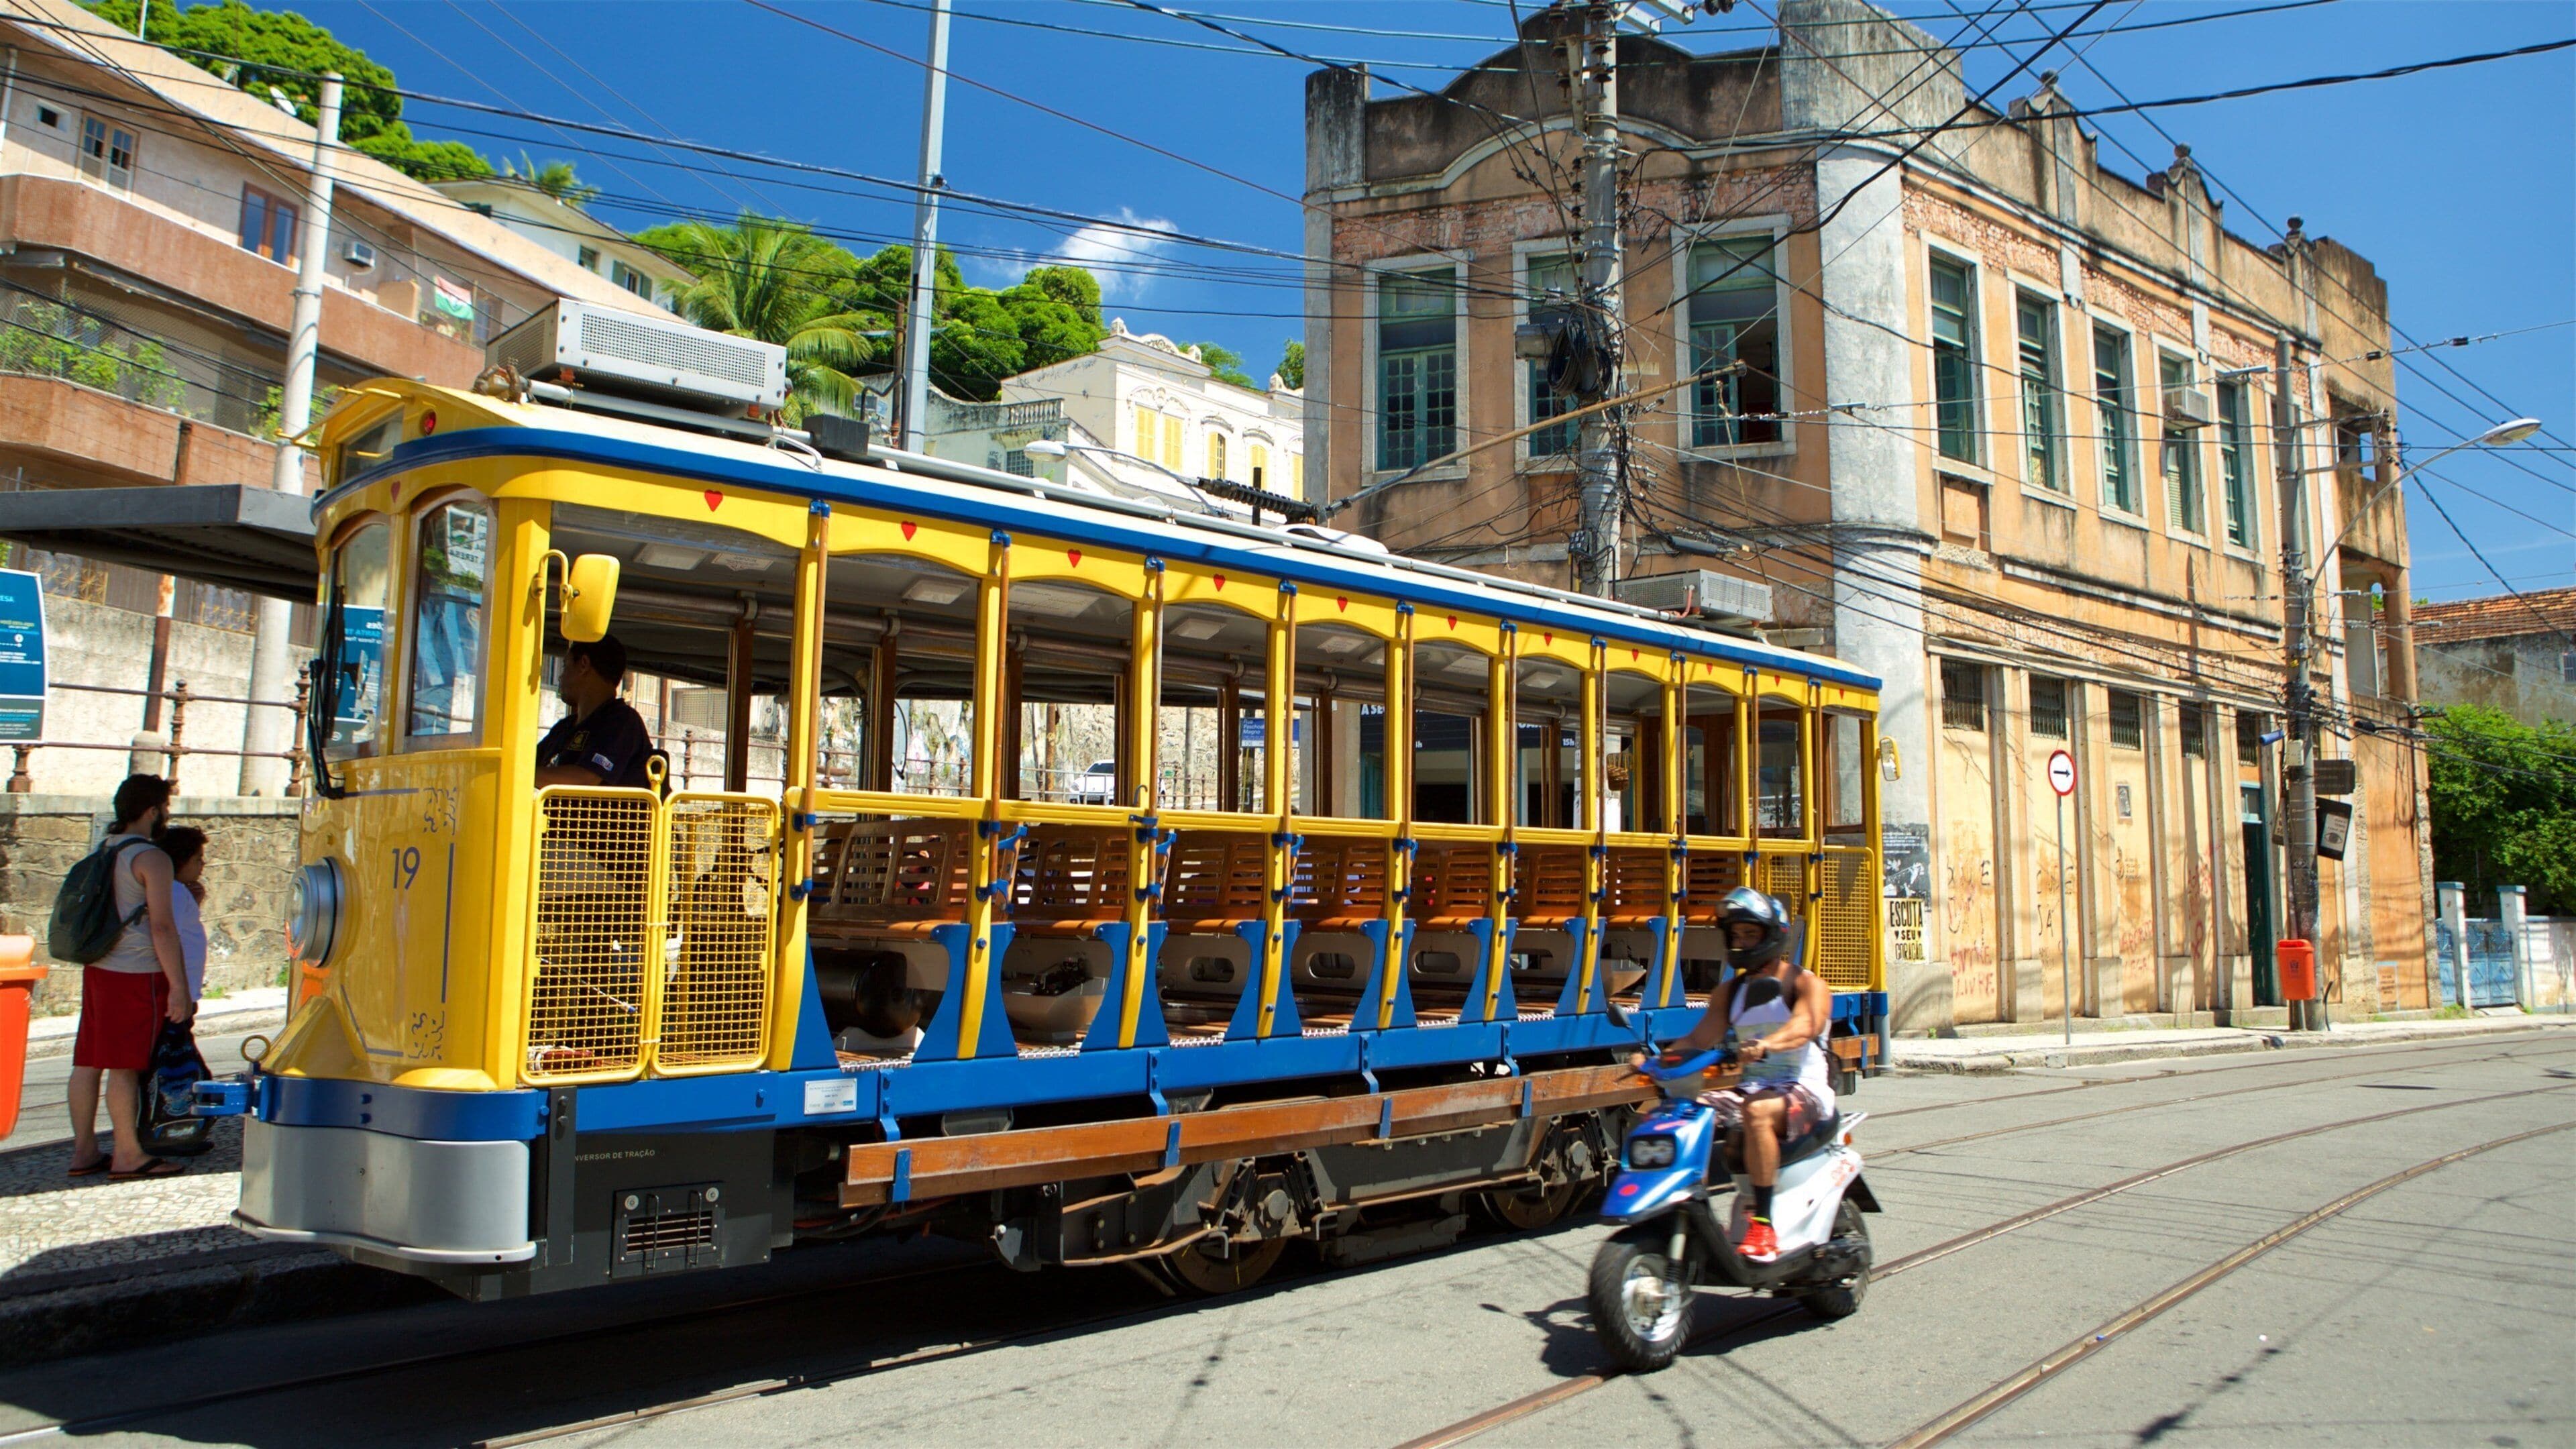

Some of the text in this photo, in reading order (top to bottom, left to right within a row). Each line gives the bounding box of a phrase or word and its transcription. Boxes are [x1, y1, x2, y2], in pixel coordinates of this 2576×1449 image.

[1361, 704, 1369, 714] A
[1562, 738, 1575, 746] 15h
[392, 846, 421, 891] 19
[1890, 900, 1923, 928] ESCUTA
[1901, 930, 1916, 941] SEU
[575, 1152, 610, 1161] NVERSOR
[625, 1149, 655, 1158] TRAÇÃO
